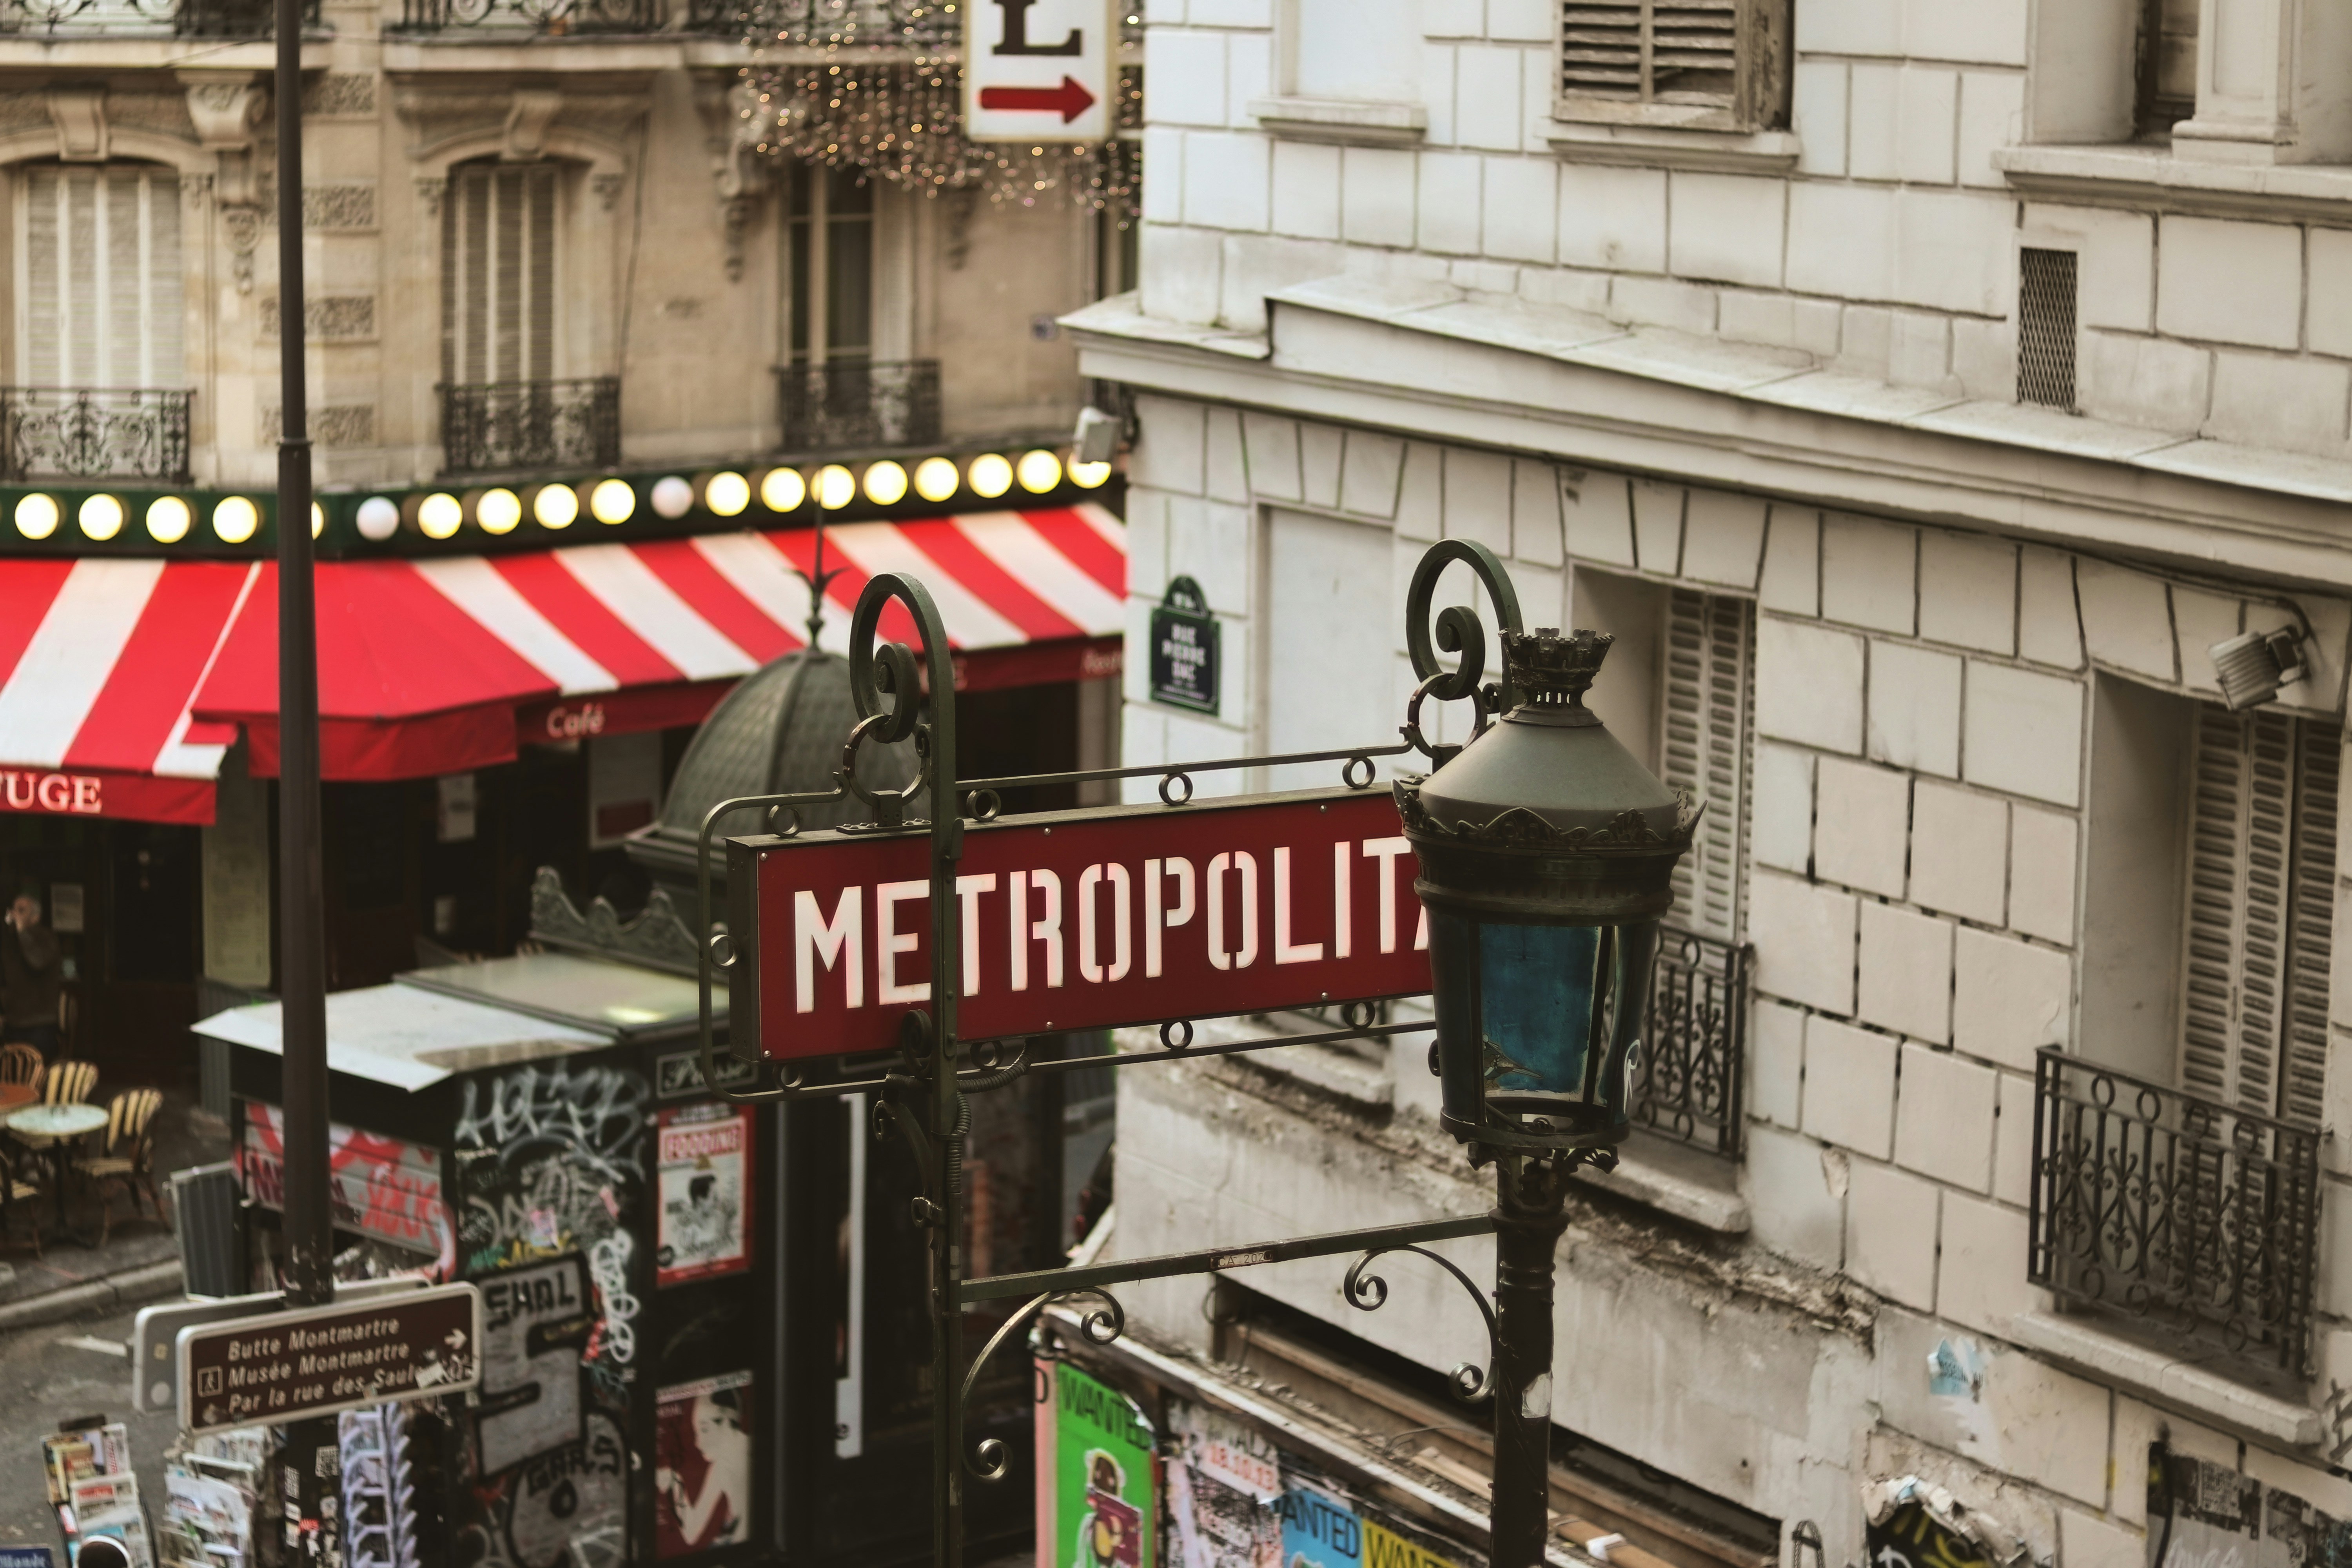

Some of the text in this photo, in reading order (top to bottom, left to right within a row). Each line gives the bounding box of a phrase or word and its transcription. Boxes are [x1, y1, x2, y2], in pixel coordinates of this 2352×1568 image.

[992, 0, 1082, 56] L
[547, 704, 604, 737] Café
[0, 771, 102, 814] UGE
[794, 835, 1429, 1014] METROPOLIT
[227, 1318, 400, 1362] Butte Montmartre
[228, 1360, 292, 1388] Musée
[298, 1342, 410, 1377] Montmartre
[228, 1393, 261, 1414] Par
[268, 1386, 287, 1408] la
[293, 1383, 325, 1404] rue
[332, 1375, 365, 1396] des
[374, 1363, 424, 1389] Saul
[1273, 1493, 1360, 1559] ANTED
